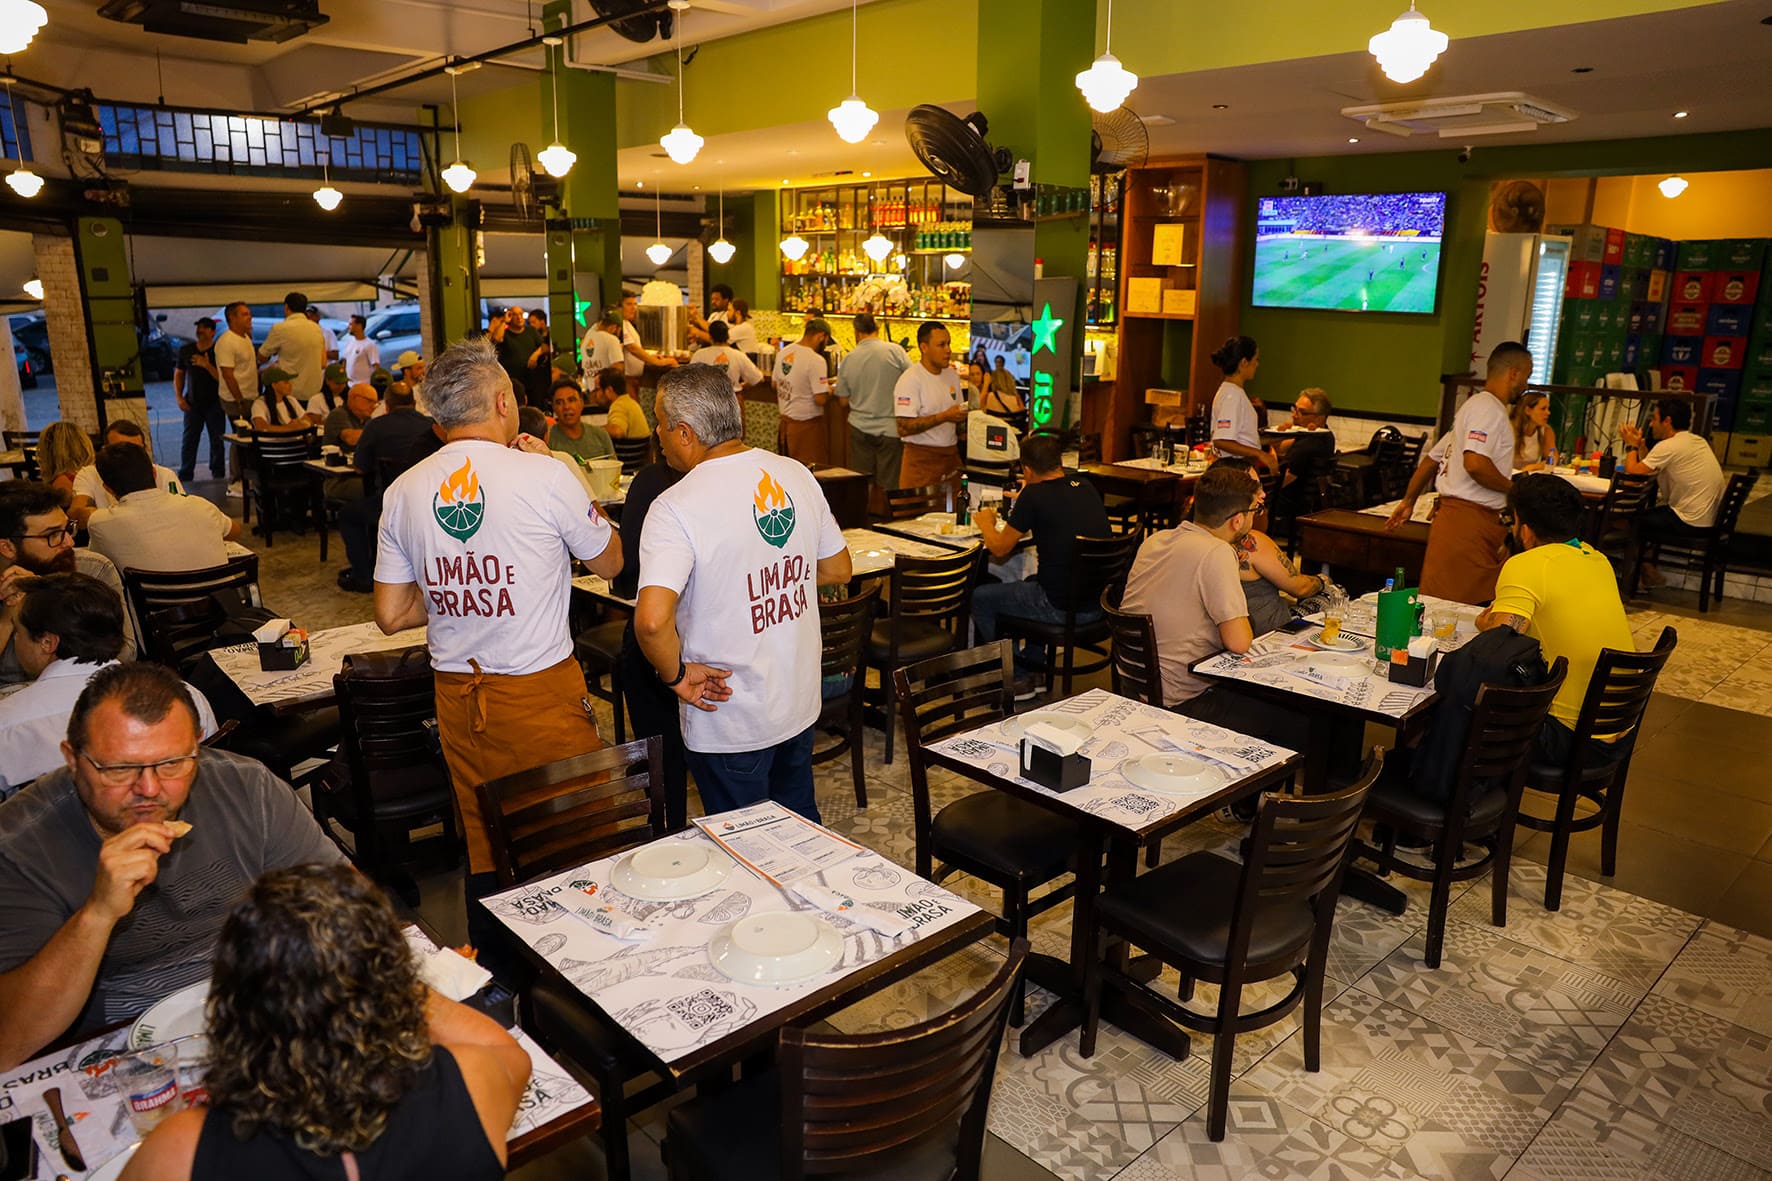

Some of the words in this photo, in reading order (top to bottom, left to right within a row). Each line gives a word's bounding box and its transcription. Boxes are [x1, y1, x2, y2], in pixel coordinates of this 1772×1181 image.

[424, 551, 500, 586] LIMÃO
[506, 565, 515, 584] E
[747, 555, 803, 602] LIMÃO
[429, 588, 515, 617] BRASA
[751, 584, 808, 634] BRASA
